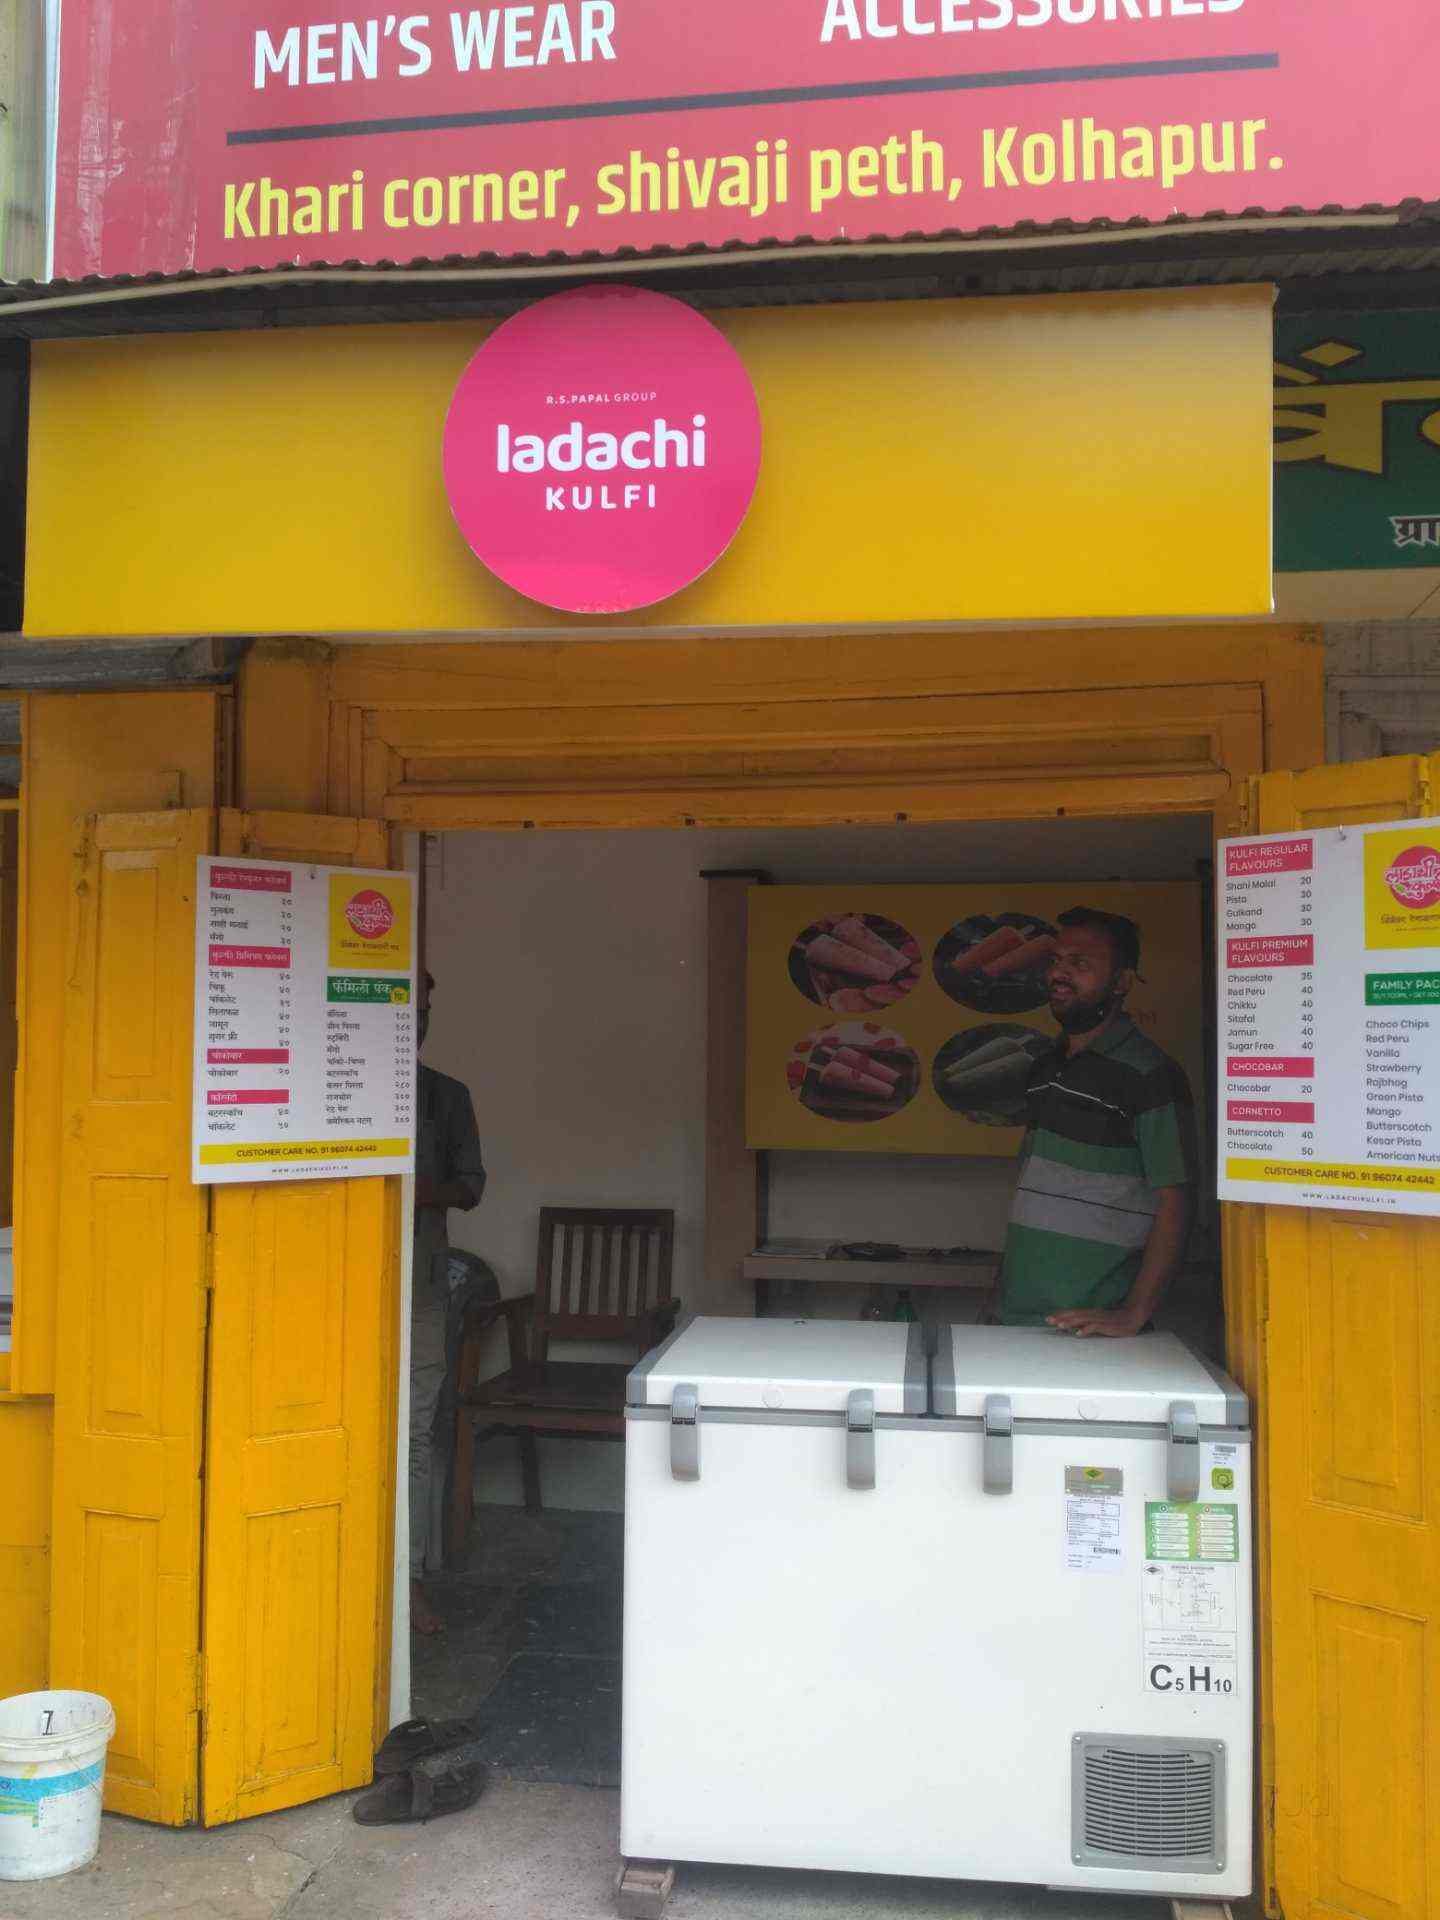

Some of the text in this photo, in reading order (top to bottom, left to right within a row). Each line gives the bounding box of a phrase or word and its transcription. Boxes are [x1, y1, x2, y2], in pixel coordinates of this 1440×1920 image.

[254, 0, 616, 89] MEN'S WEAR
[222, 117, 1285, 239] Khari corner, shivaji peth, Kolhapur.
[614, 391, 656, 403] GROUP
[496, 414, 706, 473] ladachi
[545, 484, 656, 511] KULFI
[1229, 843, 1308, 859] KULFI REGULAR
[1229, 859, 1283, 871] FLAVOURS
[1252, 879, 1276, 889] Malai
[1299, 876, 1311, 885] 20
[1226, 895, 1247, 904] Pista
[1226, 907, 1262, 917] Gulkand
[1226, 918, 1312, 932] Mango 30
[1232, 939, 1308, 951] KULFI PREMIUM
[1232, 953, 1285, 963] FLAVOURS
[1227, 974, 1273, 983] Chocolate
[1227, 985, 1313, 996] Red Peru 40
[1373, 980, 1413, 990] FAMILY
[1227, 999, 1313, 1010] Chikku 40
[1227, 1014, 1313, 1023] Sitafal 40
[1366, 1018, 1430, 1031] Choco Chips
[1227, 1027, 1313, 1037] Jamun 40
[1366, 1034, 1409, 1043] Red Peru
[1227, 1041, 1313, 1053] Sugar Free 40
[1366, 1048, 1400, 1058] Vanilla
[1232, 1063, 1285, 1071] CHOCOBAR
[1366, 1063, 1421, 1075] Strawberry
[1227, 1083, 1312, 1094] Chocobar 20
[1366, 1077, 1408, 1090] Rajbhog
[1366, 1093, 1424, 1102] Green Pista
[1232, 1107, 1282, 1117] CORNETTO
[1366, 1107, 1401, 1119] Mango
[1366, 1121, 1432, 1132] Butterscotch
[1227, 1128, 1313, 1140] Butterscotch 40
[1366, 1136, 1422, 1147] Kesar Pista
[236, 1148, 281, 1157] CUSTOMER
[282, 1148, 303, 1157] CARE
[1227, 1142, 1313, 1156] Chocolate 50
[1366, 1150, 1416, 1161] American
[1264, 1166, 1313, 1178] CUSTOMER
[1314, 1169, 1341, 1179] CARE
[1361, 1172, 1370, 1181] 91
[1371, 1172, 1402, 1183] 96074
[1405, 1174, 1435, 1185] 42442
